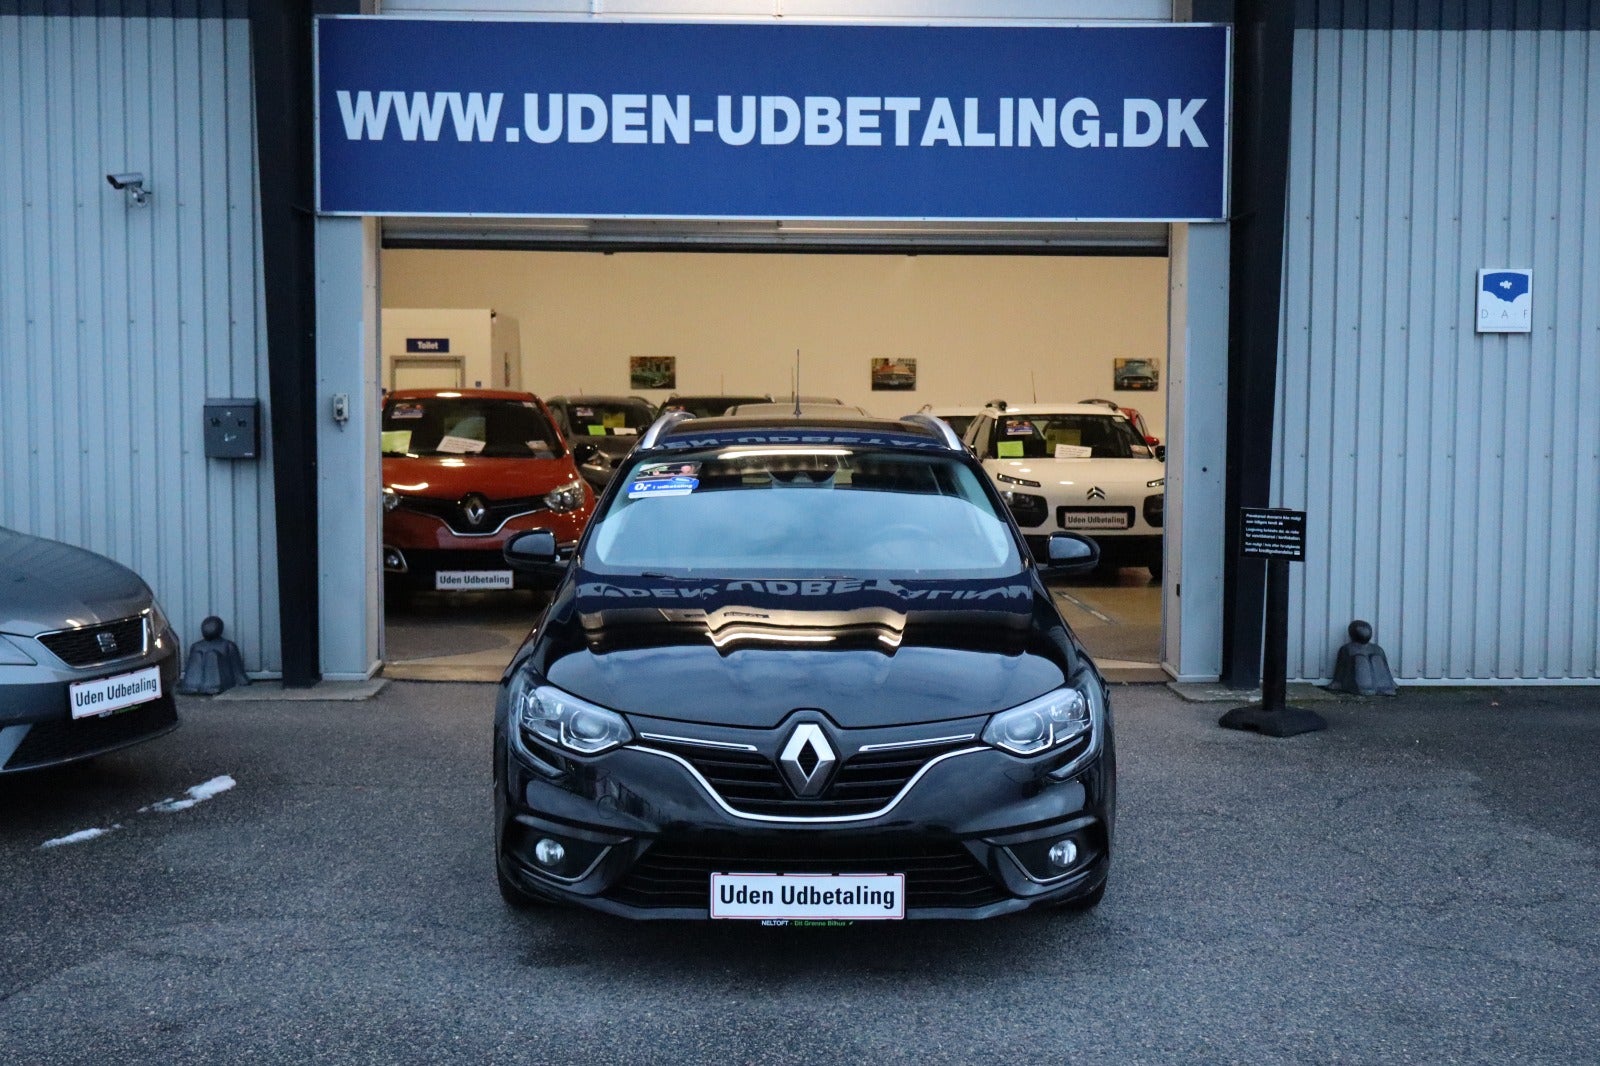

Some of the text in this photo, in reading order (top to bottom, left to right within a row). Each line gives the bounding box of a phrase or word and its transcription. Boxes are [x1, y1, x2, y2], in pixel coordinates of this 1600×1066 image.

[336, 90, 1209, 149] WWW.UDEN-UDBETALING.DK
[417, 341, 439, 350] Toilet
[439, 574, 511, 588] Uden Udbetaling
[75, 677, 158, 707] Uden Udbetaling
[720, 884, 896, 910] Uden Udbetaling
